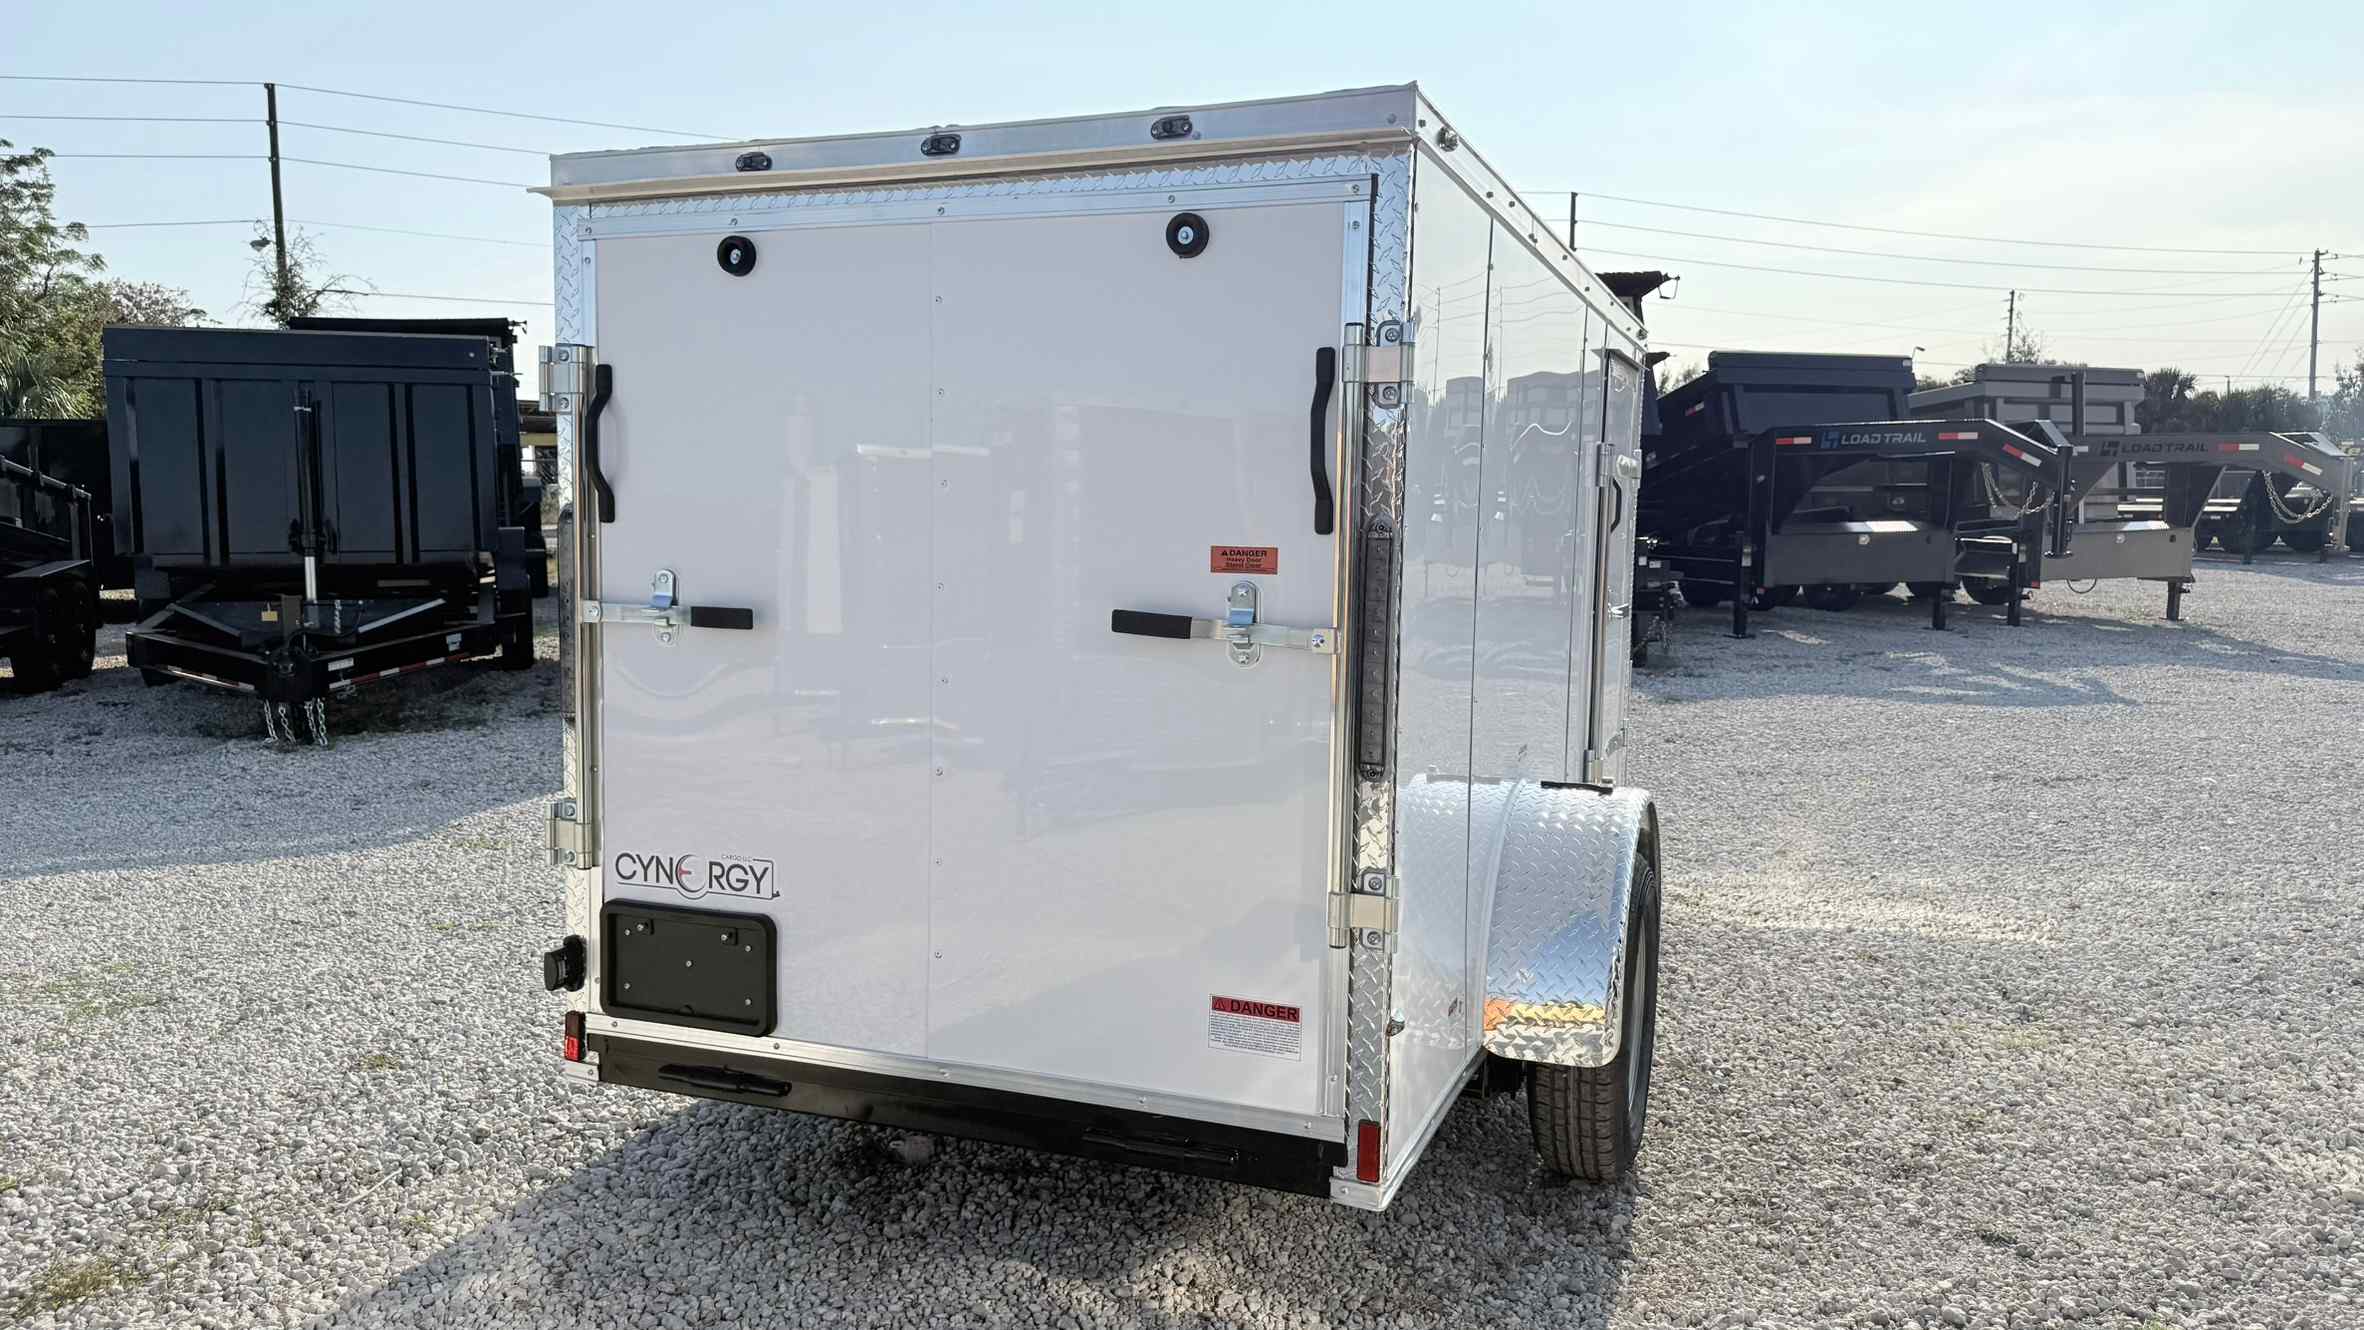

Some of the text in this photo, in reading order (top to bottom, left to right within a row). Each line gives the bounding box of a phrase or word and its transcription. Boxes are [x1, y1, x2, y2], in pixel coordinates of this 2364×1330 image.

[1840, 432, 1926, 445] LOAD TRAIL
[615, 852, 769, 895] CYNERGY
[1231, 999, 1297, 1020] DANGER
